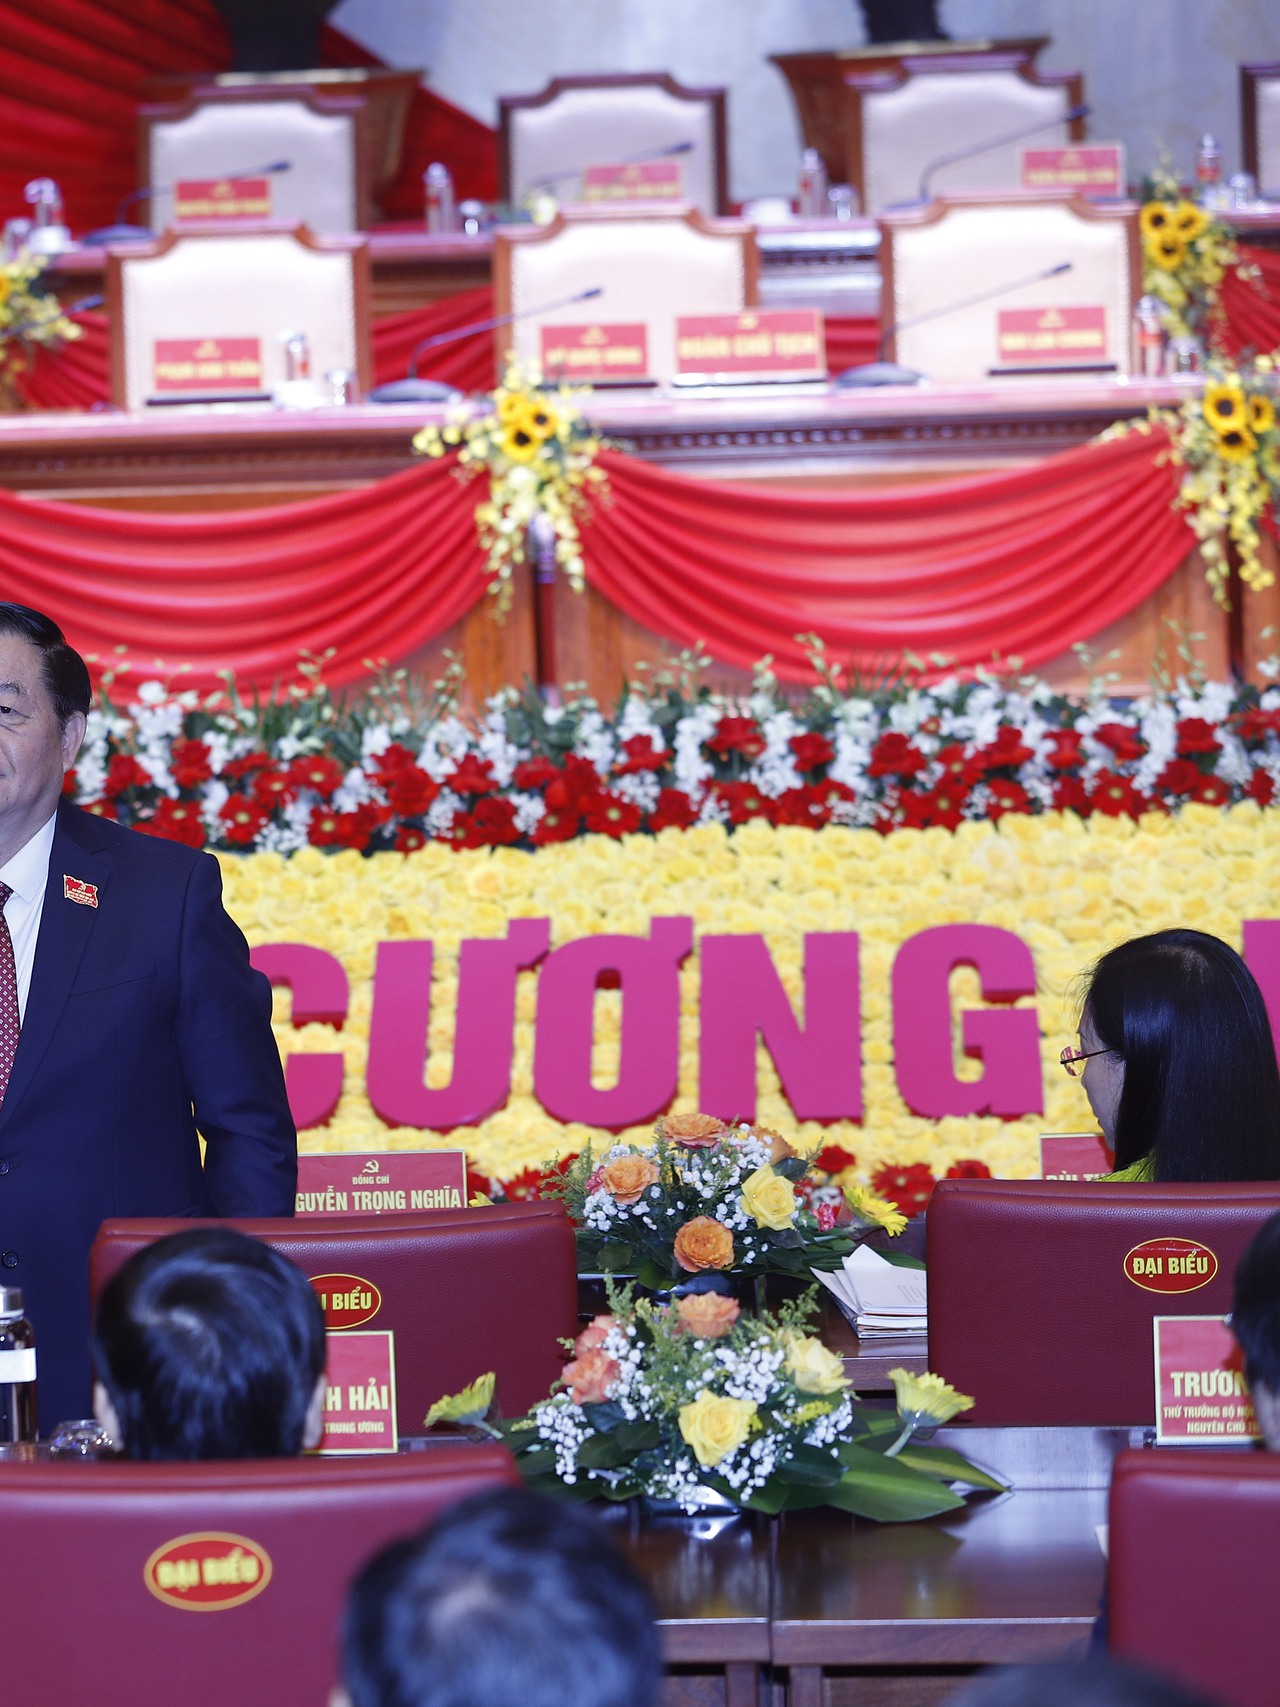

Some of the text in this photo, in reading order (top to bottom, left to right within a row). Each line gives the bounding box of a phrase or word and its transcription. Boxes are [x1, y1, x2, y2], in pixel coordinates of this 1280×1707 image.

[376, 1174, 390, 1184] CHÍ
[295, 1185, 462, 1214] GUYỄN TRỌNG NGHĨA
[1132, 1249, 1208, 1278] ĐẠI BIỂU
[332, 1286, 372, 1310] BIỂU
[348, 1377, 389, 1411] HẢI
[1170, 1369, 1249, 1397] TRƯƠN
[324, 1421, 384, 1434] TRUNG ƯƠNG
